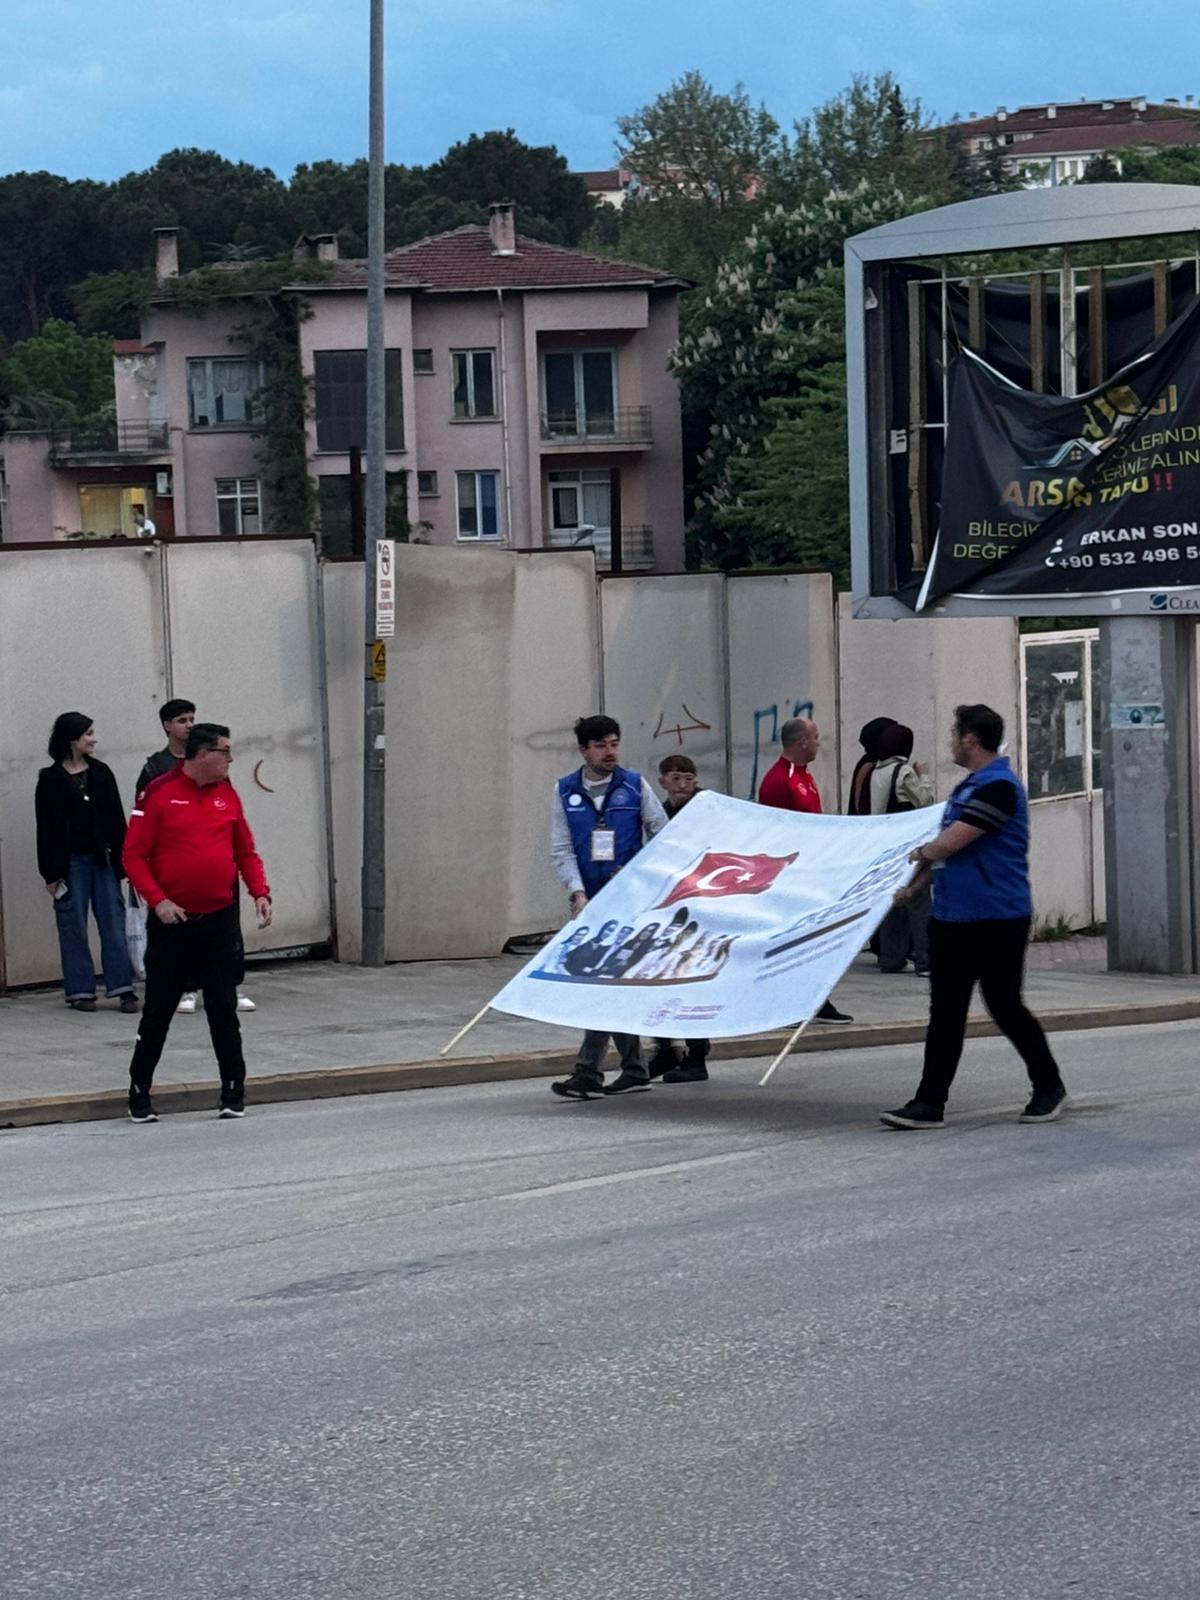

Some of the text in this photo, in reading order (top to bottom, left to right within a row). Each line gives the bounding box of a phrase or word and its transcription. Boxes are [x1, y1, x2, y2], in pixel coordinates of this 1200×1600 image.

[1080, 522, 1200, 546] ERKAN SON
[1059, 546, 1200, 569] +90 532 496 5
